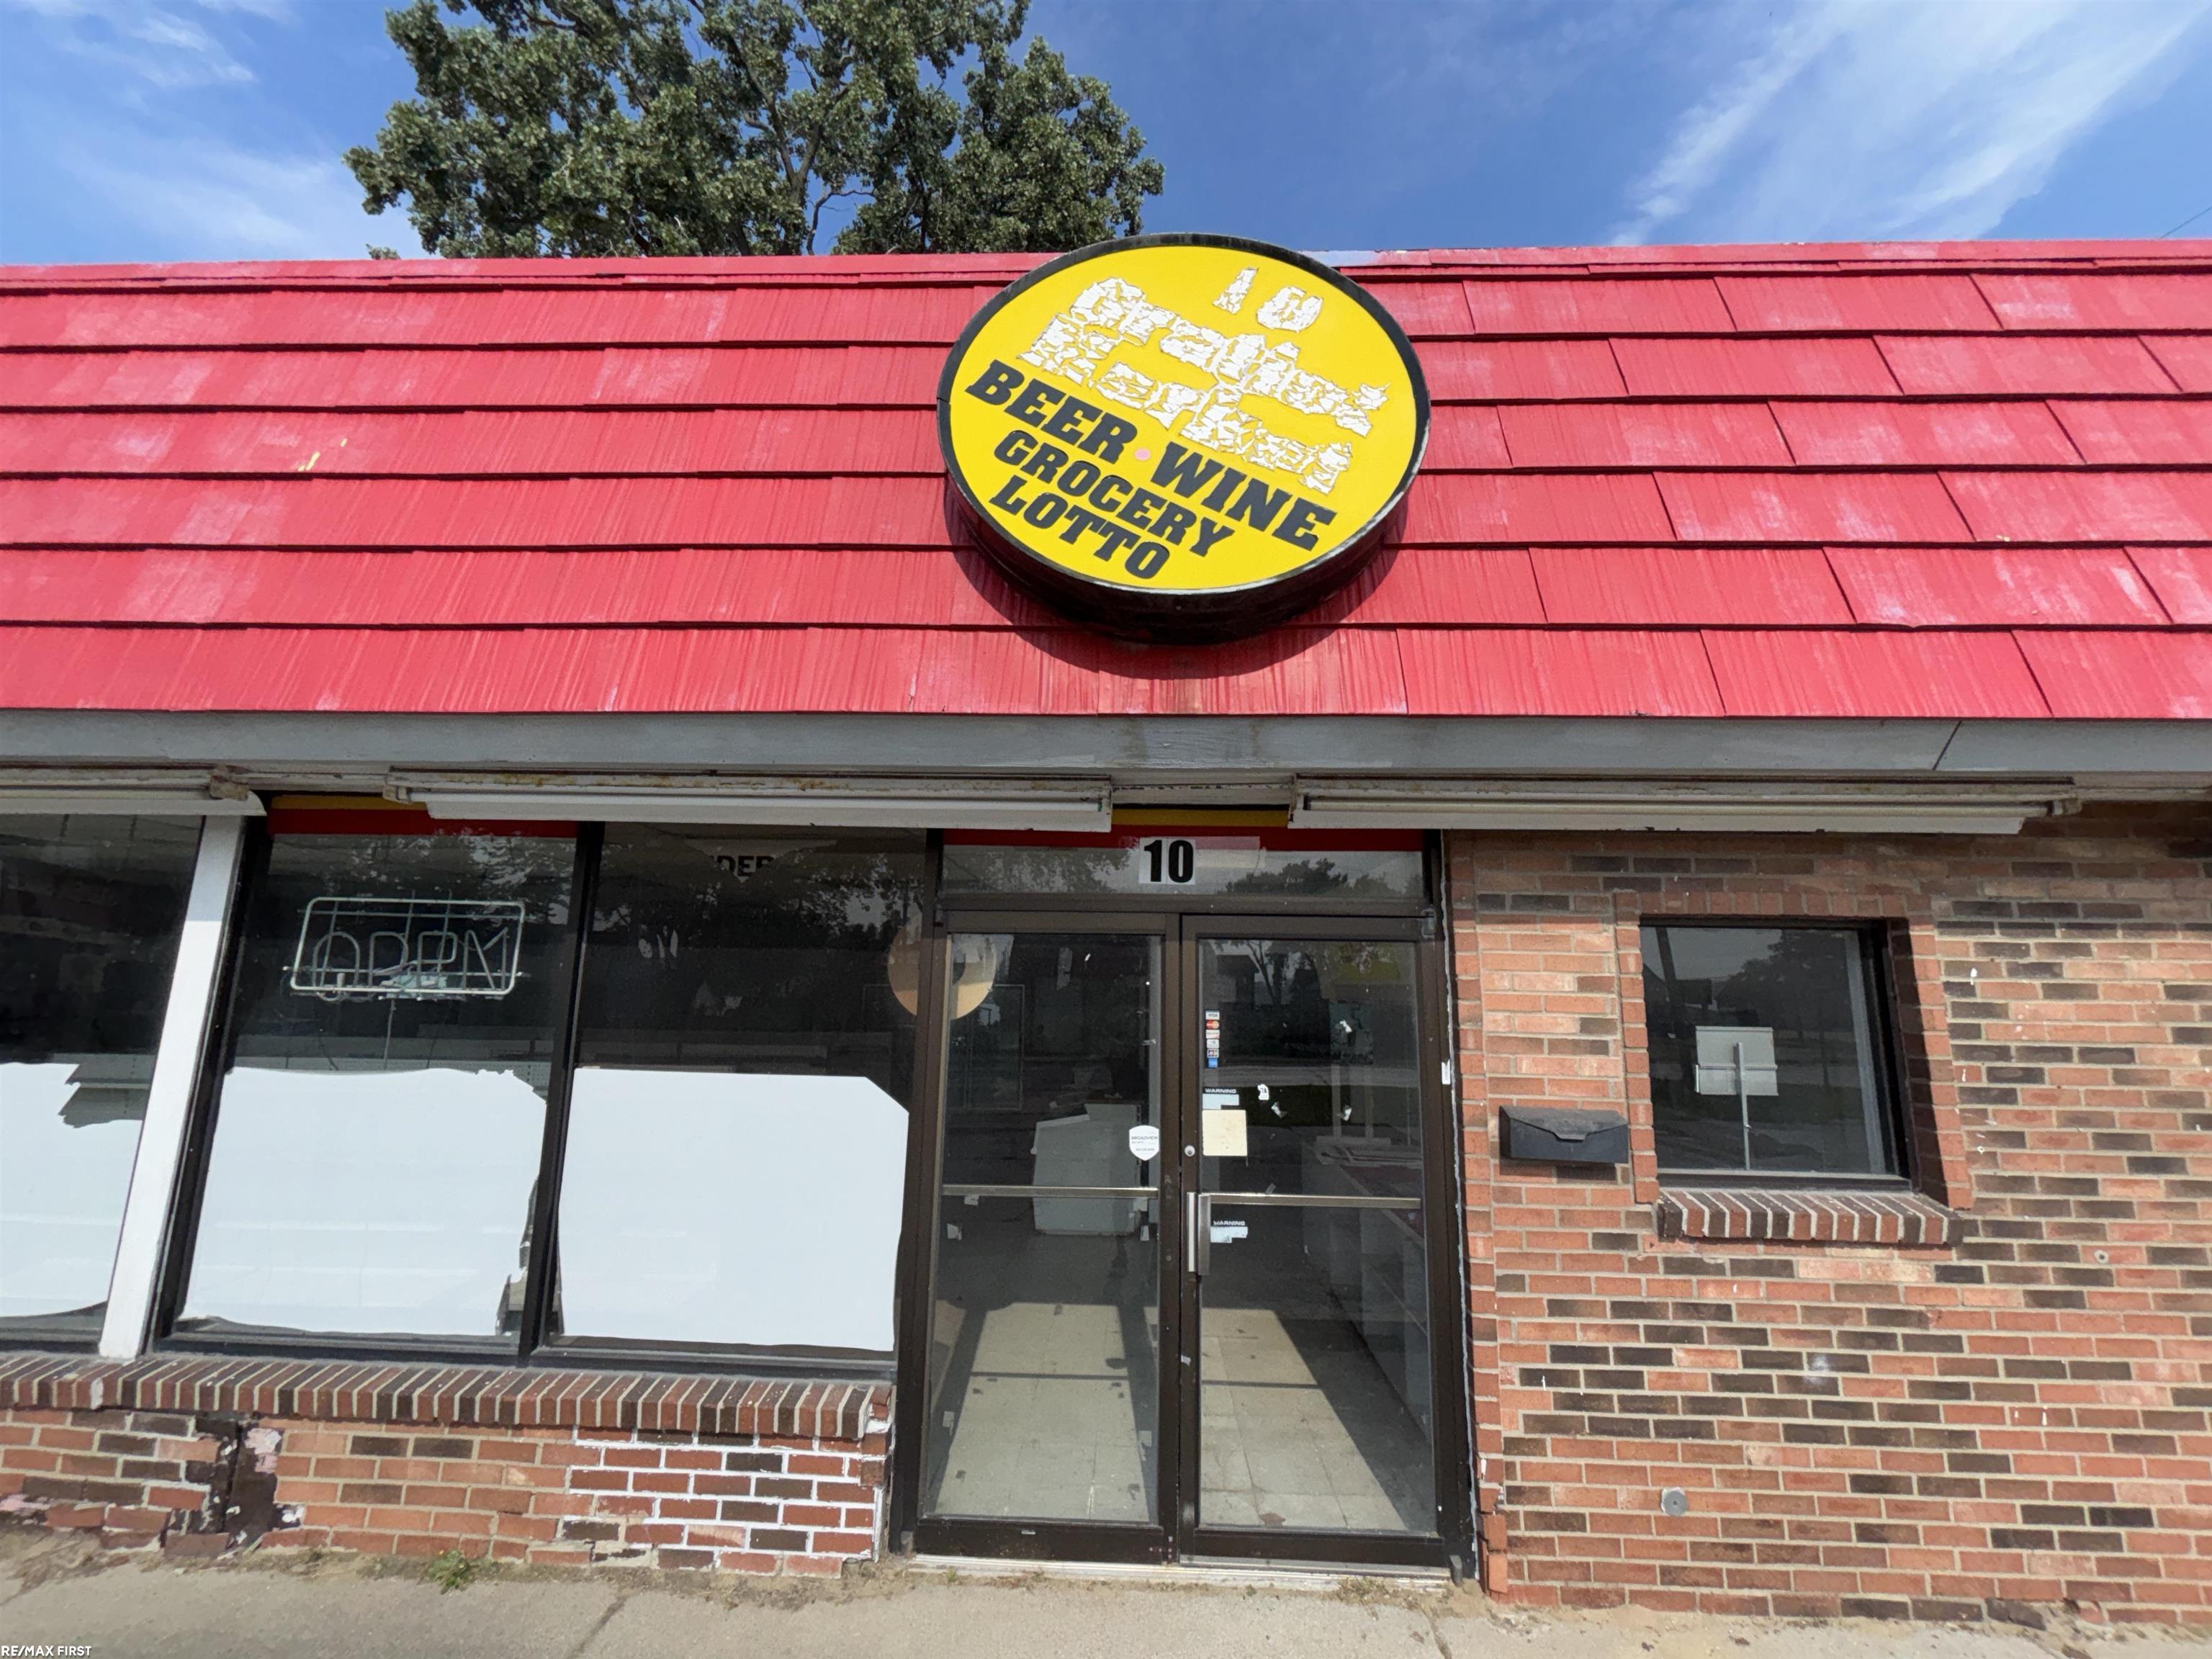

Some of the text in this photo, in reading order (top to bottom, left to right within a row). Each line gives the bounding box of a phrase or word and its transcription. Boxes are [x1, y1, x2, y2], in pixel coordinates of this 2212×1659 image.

[965, 360, 1337, 552] BEER WINE
[994, 430, 1235, 557] GROCERY
[989, 475, 1170, 580] LOTTO
[1143, 839, 1194, 884] 10
